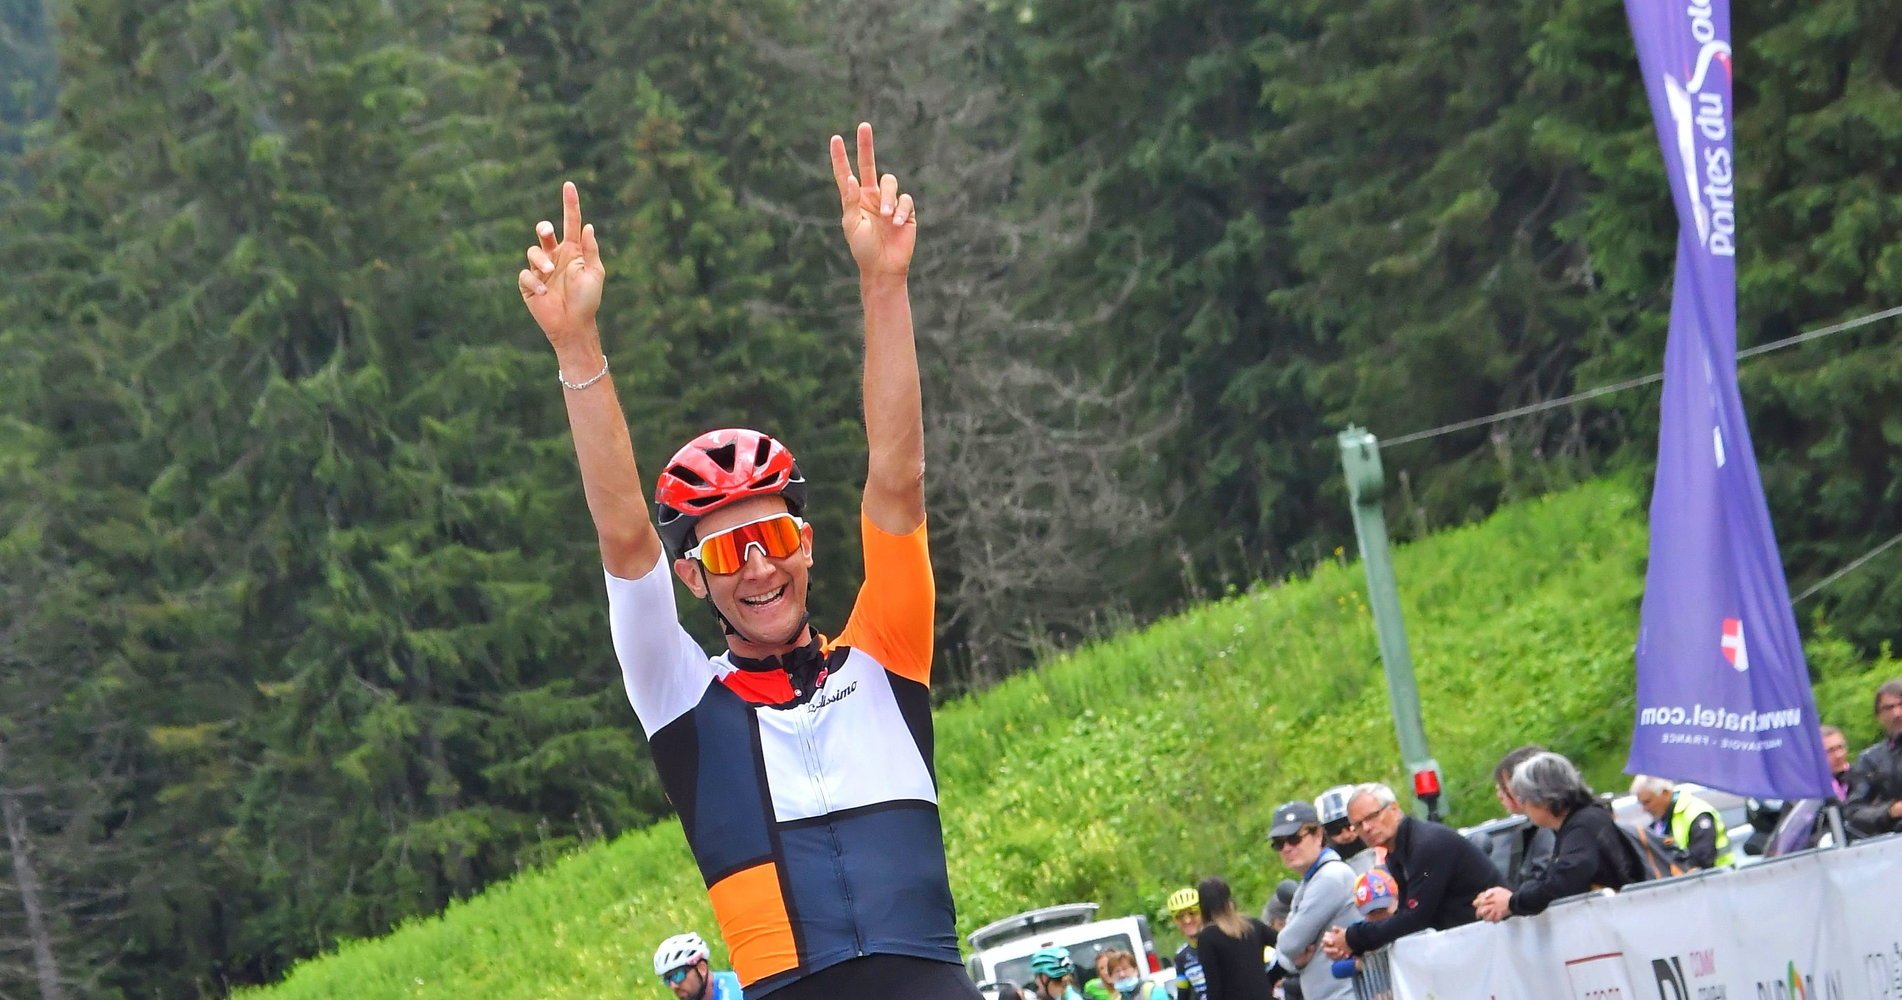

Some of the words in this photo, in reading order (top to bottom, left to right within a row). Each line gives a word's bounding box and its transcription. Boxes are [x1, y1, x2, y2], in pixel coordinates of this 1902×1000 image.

[1686, 0, 1732, 94] Sol
[1696, 92, 1727, 141] du
[1703, 146, 1736, 257] Portes
